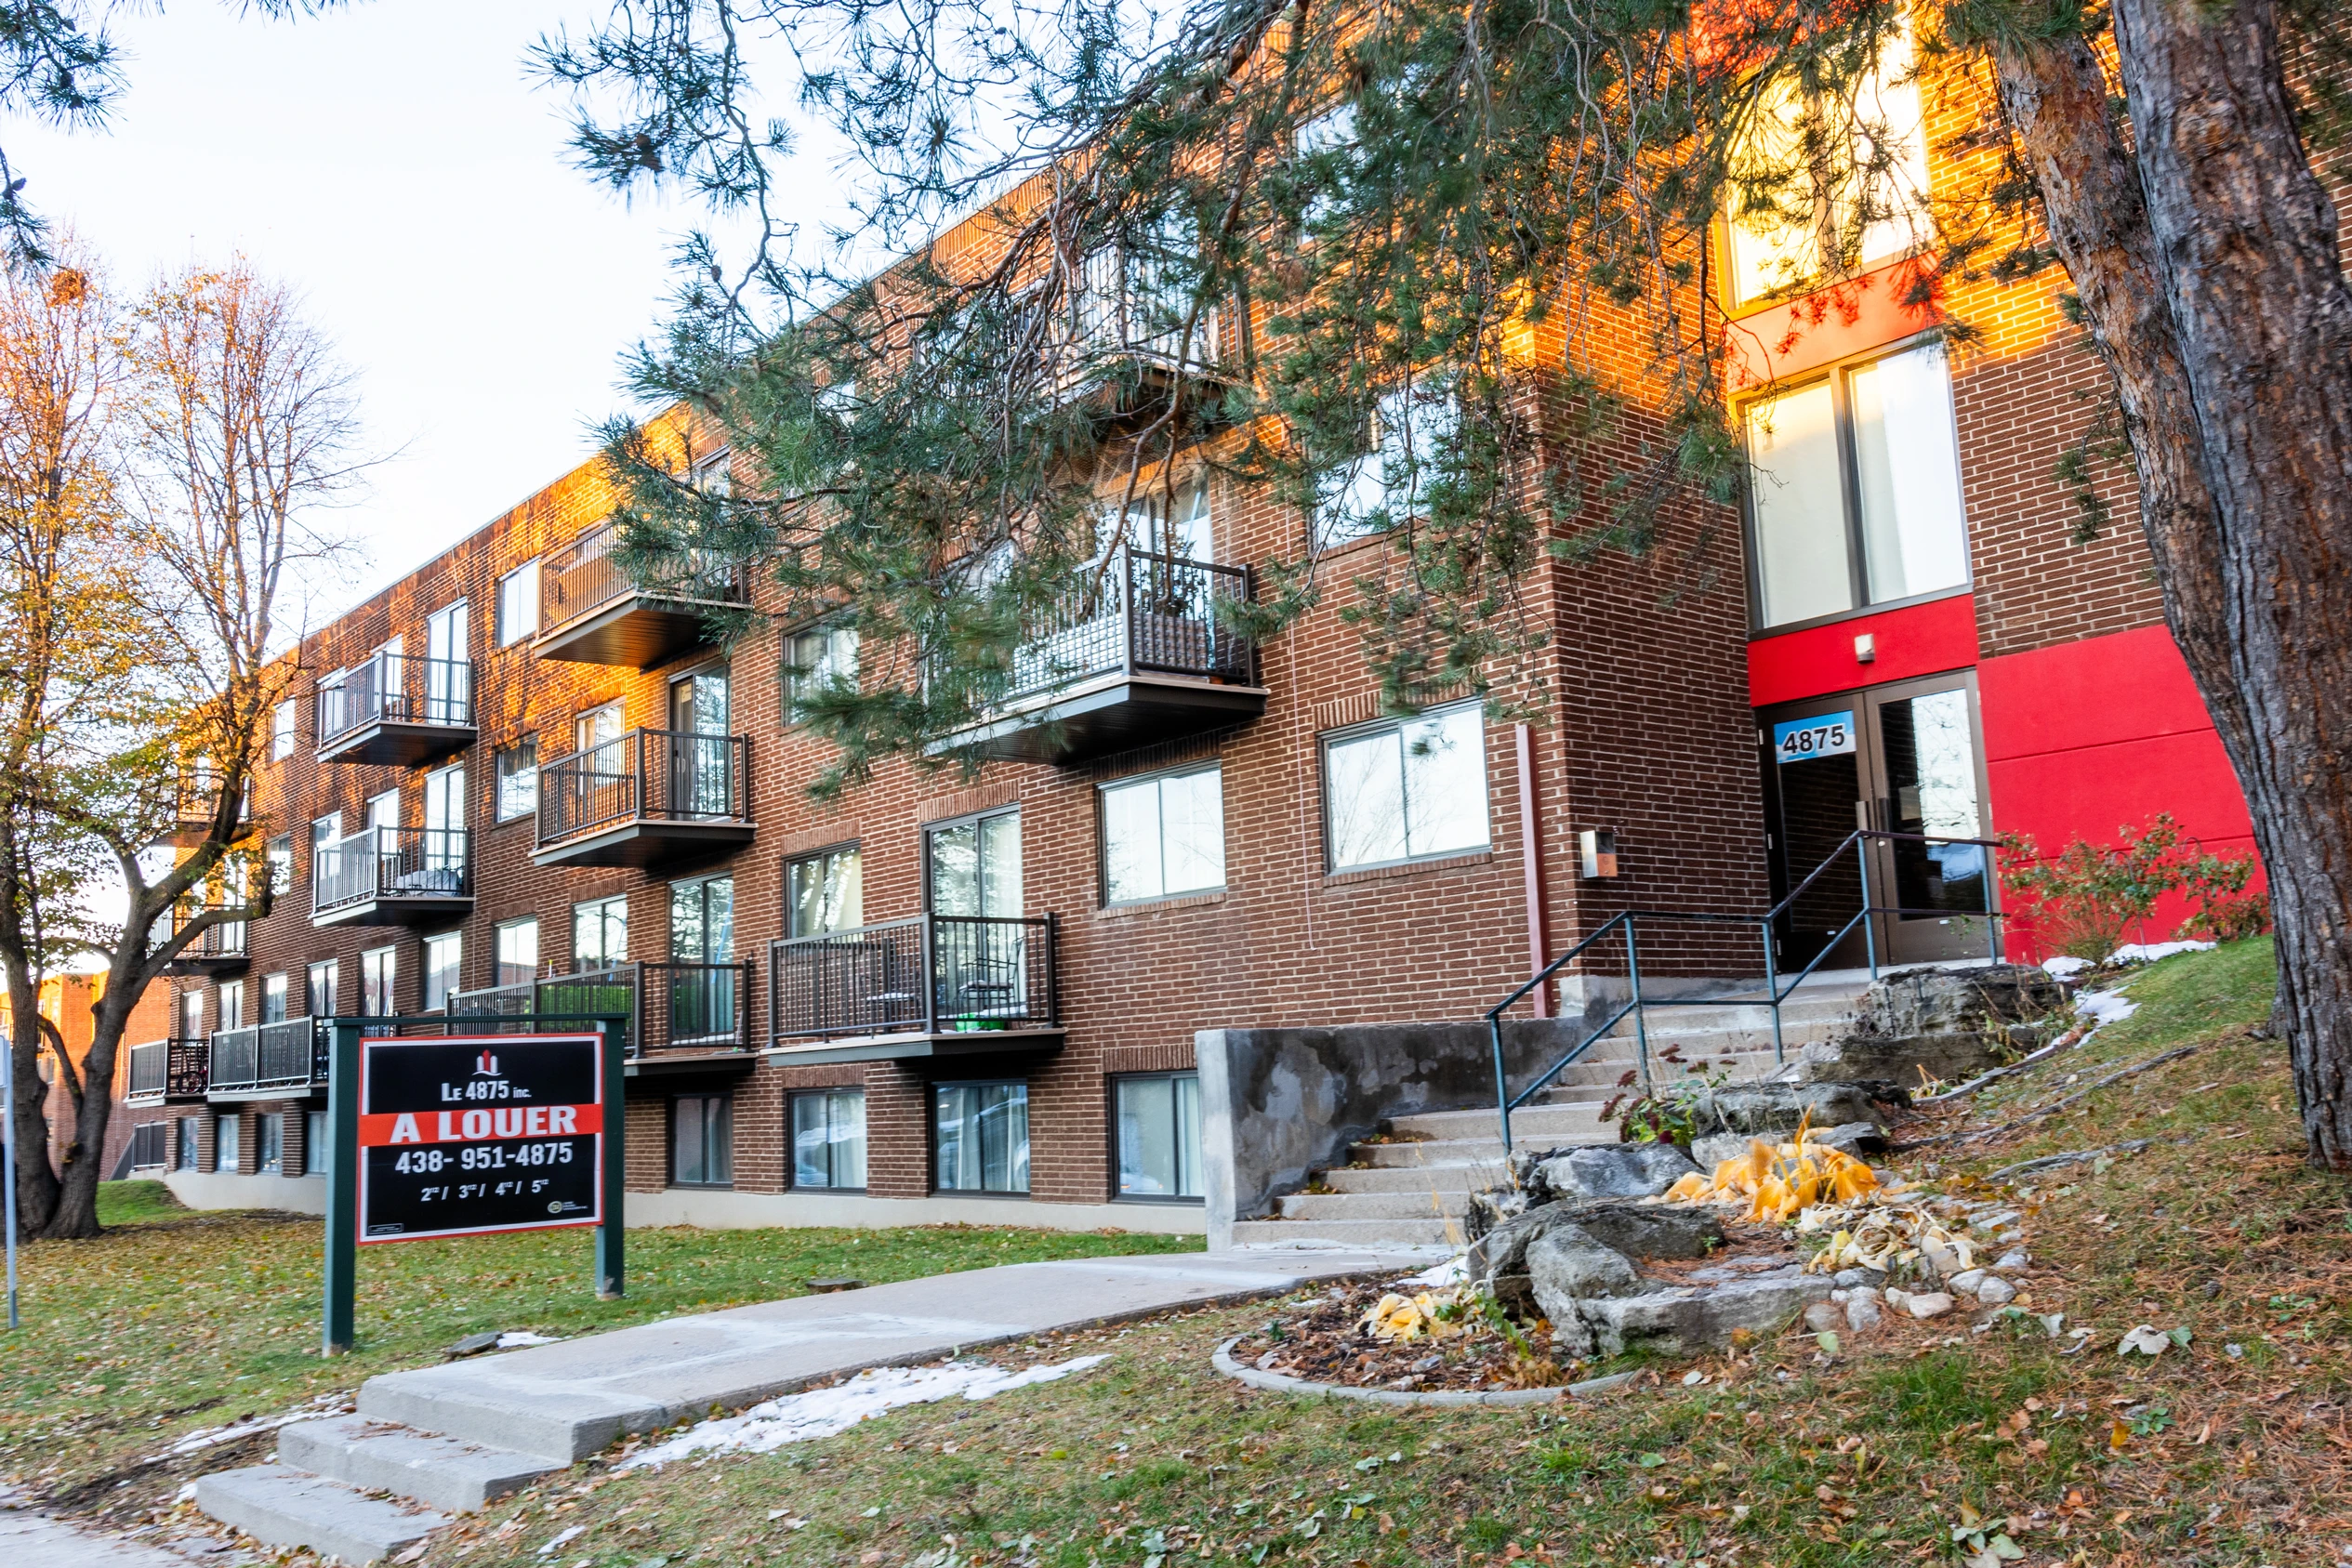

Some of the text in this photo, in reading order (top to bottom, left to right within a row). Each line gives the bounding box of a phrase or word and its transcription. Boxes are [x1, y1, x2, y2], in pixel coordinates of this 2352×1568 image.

[1782, 724, 1845, 754] 4875
[465, 1080, 509, 1100] 4875
[390, 1105, 577, 1143] A LOUER
[460, 1141, 574, 1170] 951-4875
